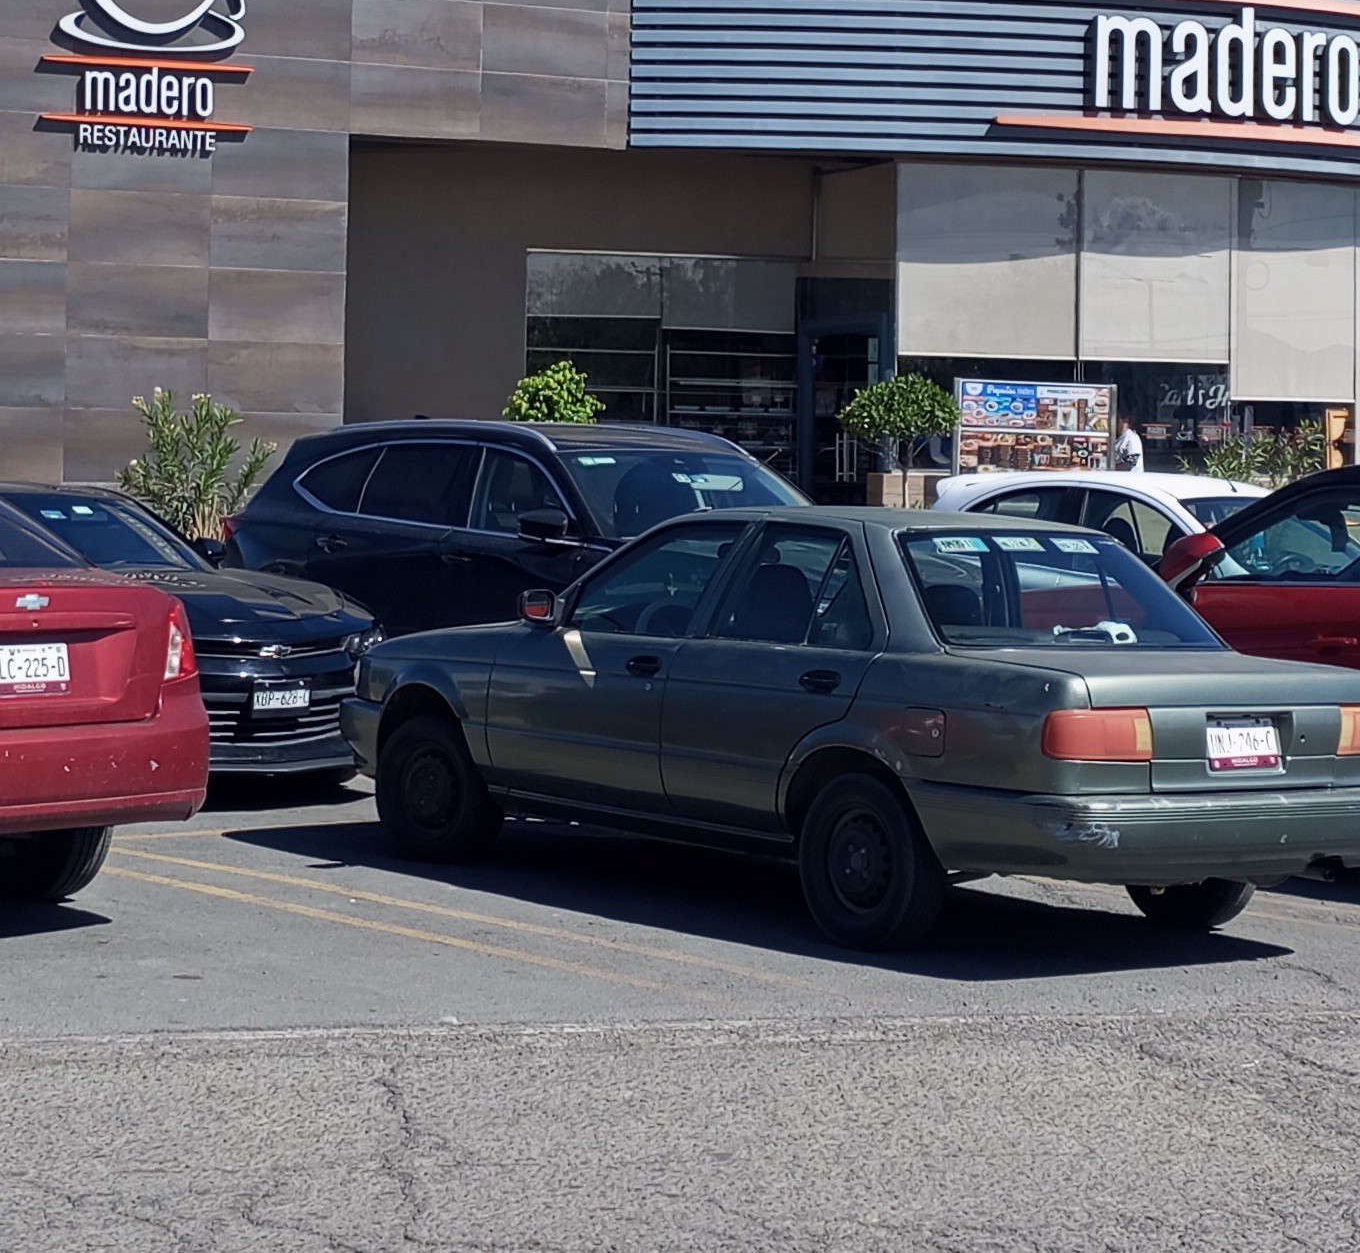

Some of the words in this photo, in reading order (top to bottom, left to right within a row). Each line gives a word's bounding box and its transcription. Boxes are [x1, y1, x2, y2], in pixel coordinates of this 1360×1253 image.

[84, 66, 214, 117] madero
[1095, 7, 1359, 125] madero
[78, 123, 217, 151] RESTAURANTE
